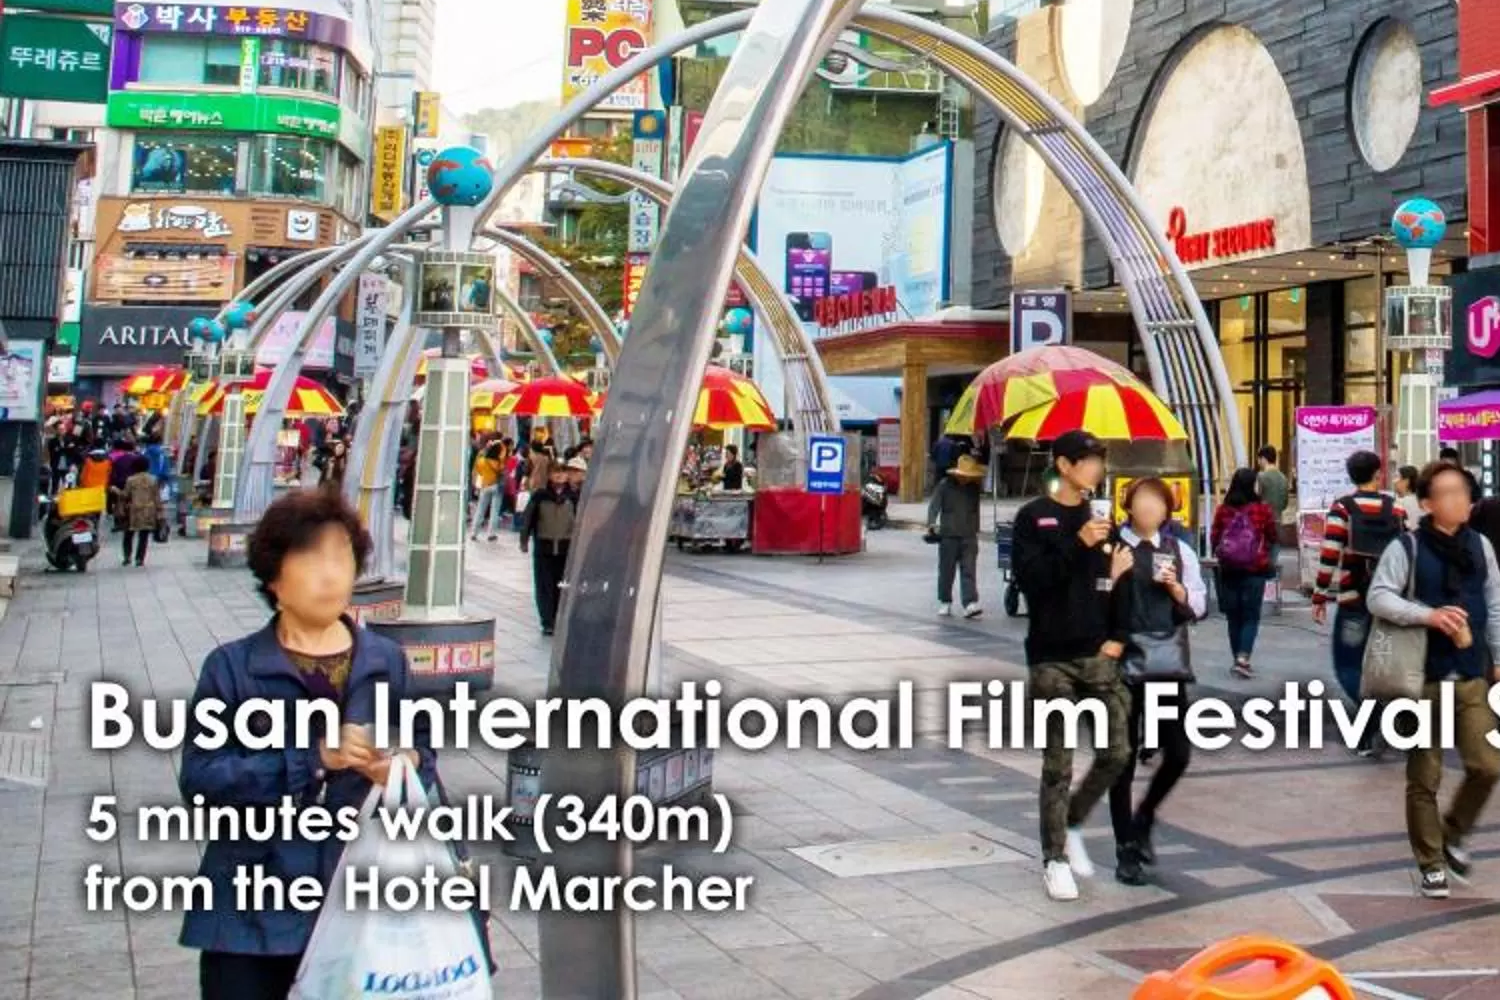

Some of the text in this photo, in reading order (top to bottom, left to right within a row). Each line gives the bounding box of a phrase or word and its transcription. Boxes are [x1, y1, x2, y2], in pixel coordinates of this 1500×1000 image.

[156, 5, 217, 31] 박사
[224, 6, 309, 32] 부동산
[9, 45, 105, 73] 뚜레쥬르
[568, 27, 646, 69] PC
[816, 445, 839, 469] P
